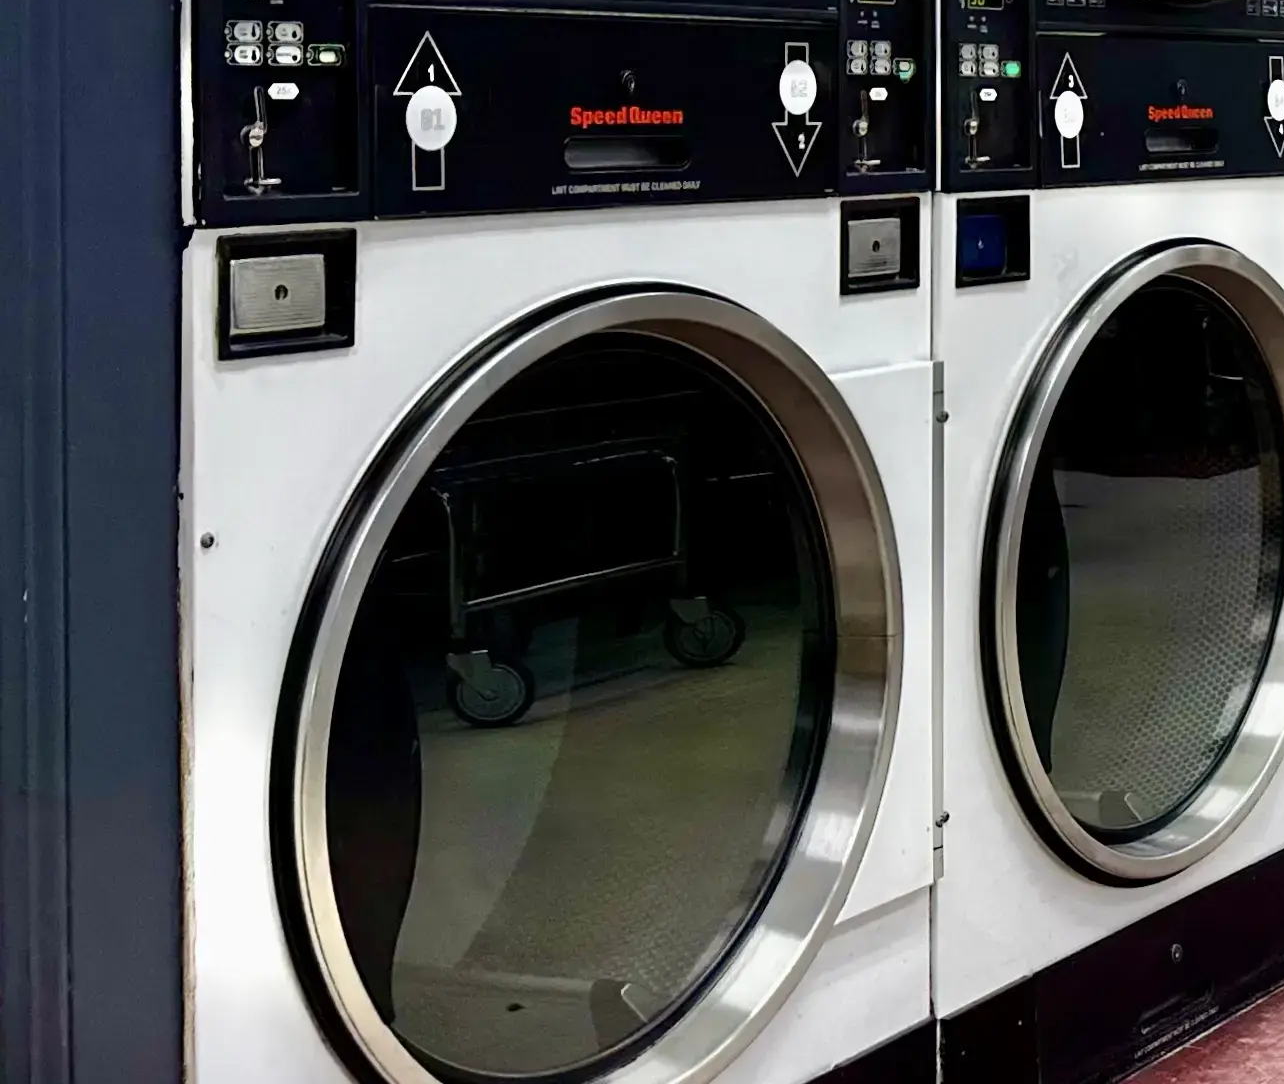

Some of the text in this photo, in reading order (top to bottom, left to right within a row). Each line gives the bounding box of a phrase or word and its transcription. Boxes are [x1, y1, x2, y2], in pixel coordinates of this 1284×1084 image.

[427, 63, 435, 82] 1
[569, 104, 684, 129] Speed Queen
